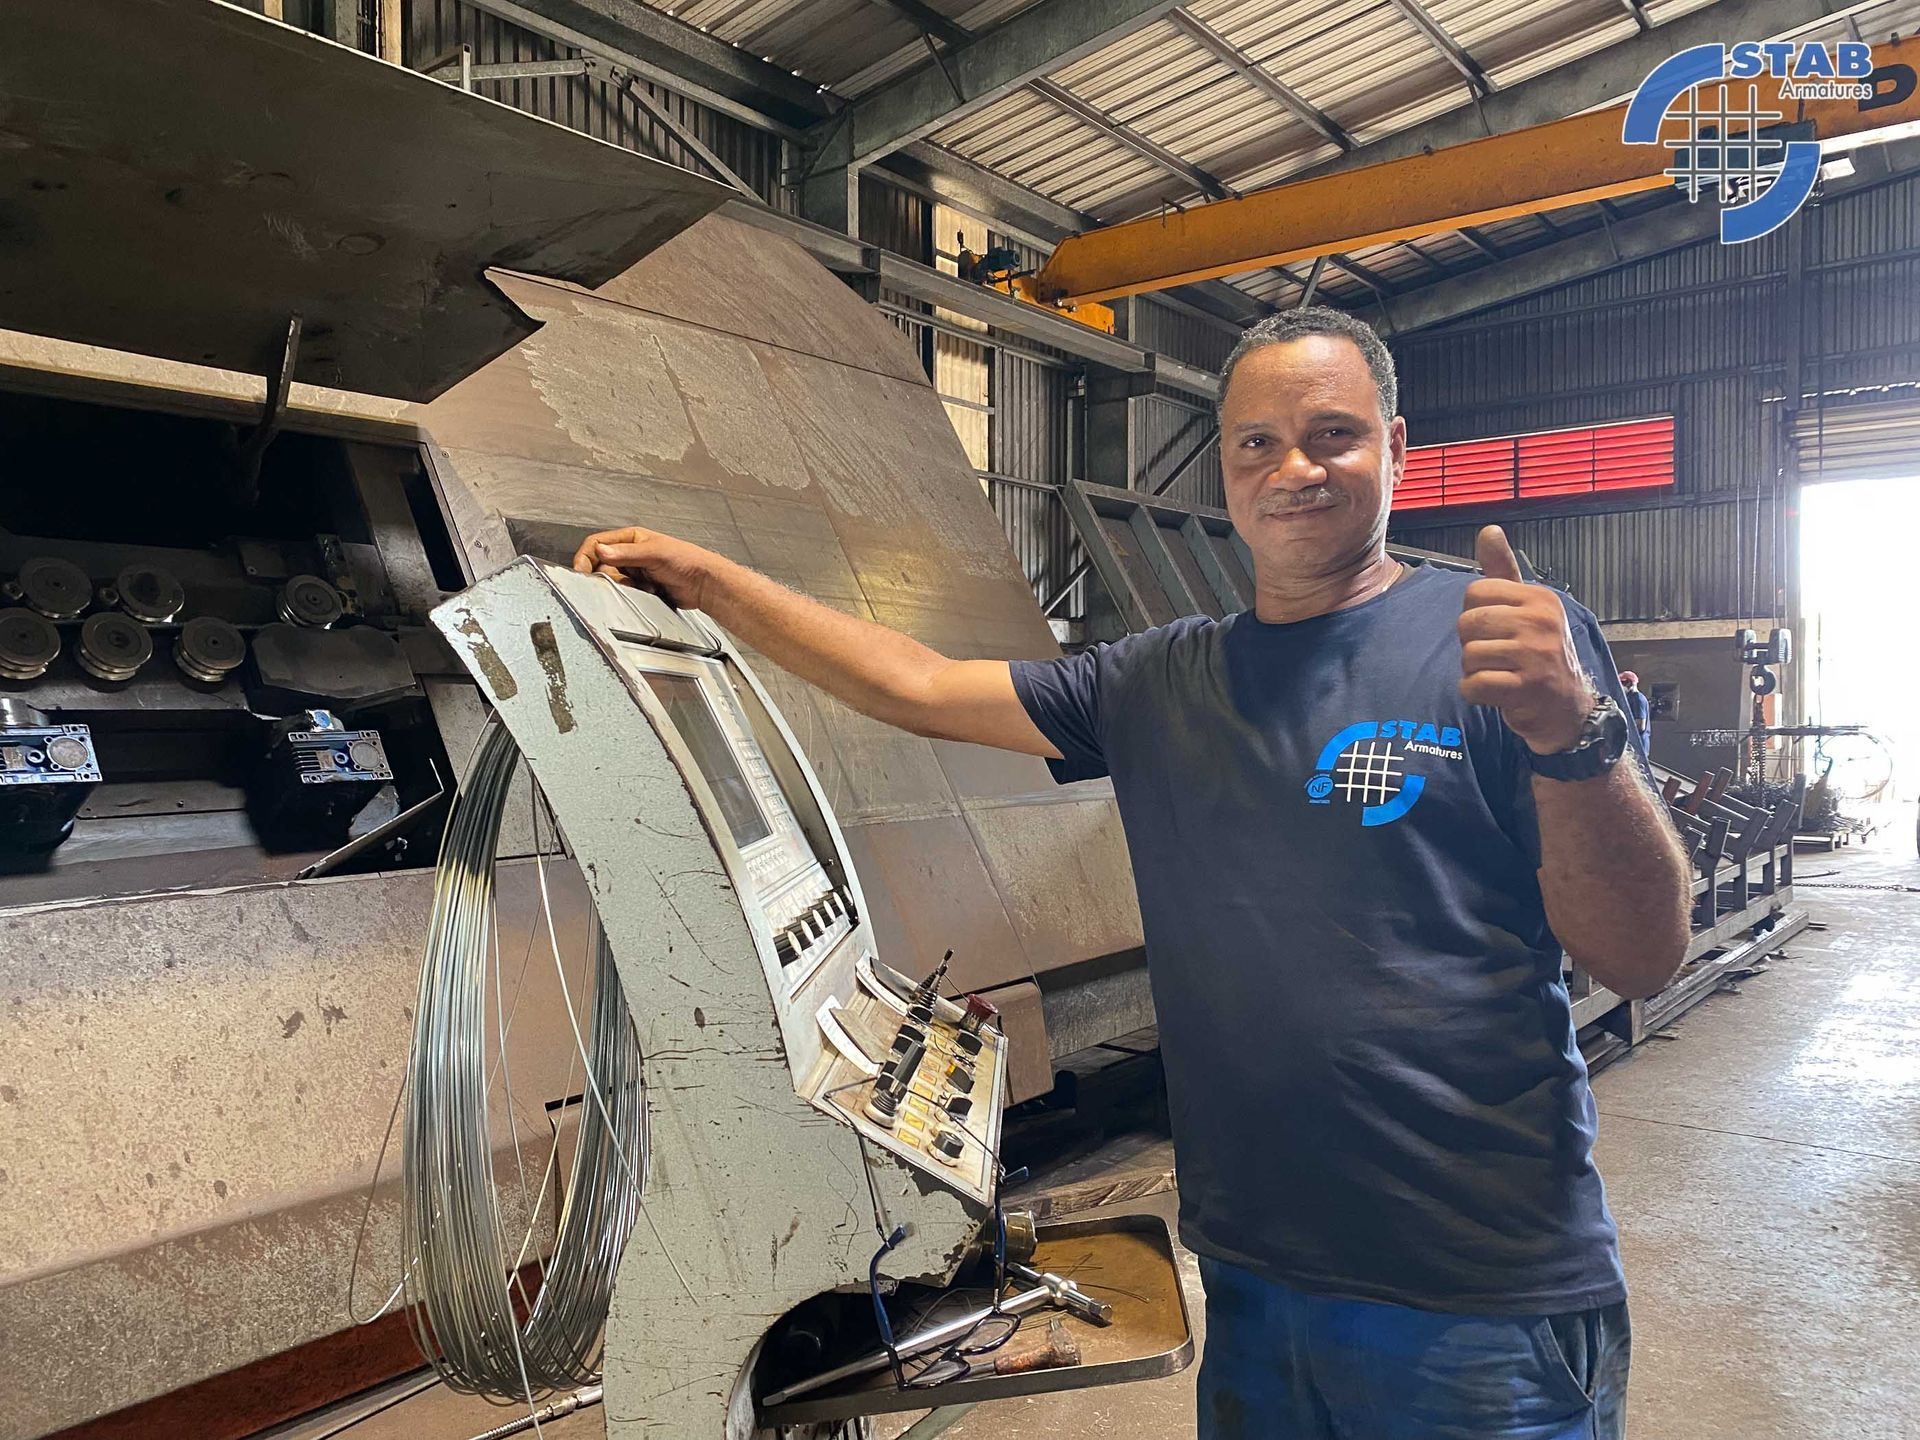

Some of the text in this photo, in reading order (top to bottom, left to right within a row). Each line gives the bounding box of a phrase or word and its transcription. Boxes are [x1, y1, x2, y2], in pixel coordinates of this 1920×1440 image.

[1381, 721, 1461, 746] STAB
[1405, 740, 1462, 760] Armatures
[1311, 781, 1331, 793] NF
